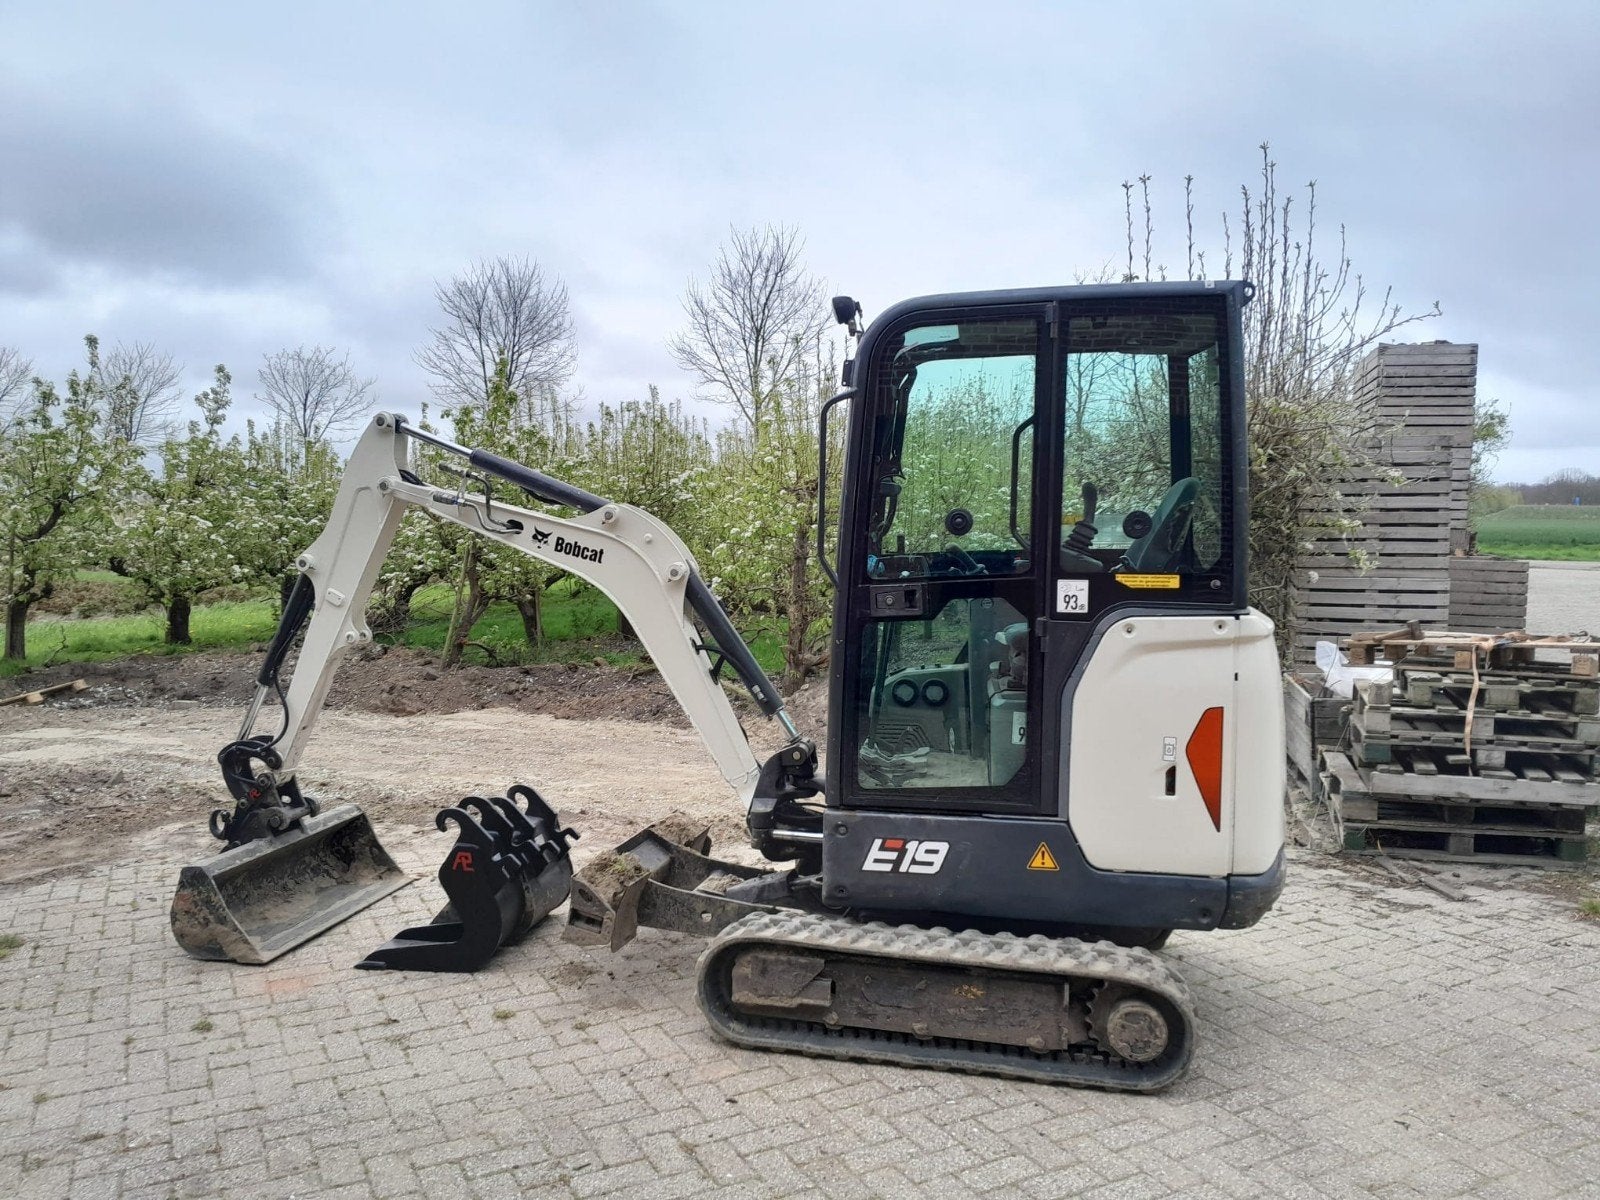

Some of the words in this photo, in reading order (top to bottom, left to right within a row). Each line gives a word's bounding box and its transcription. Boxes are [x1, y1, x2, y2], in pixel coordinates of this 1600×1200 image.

[554, 536, 604, 564] Bobcat
[1063, 594, 1078, 610] 93
[1018, 726, 1026, 742] 9
[862, 838, 950, 875] E19
